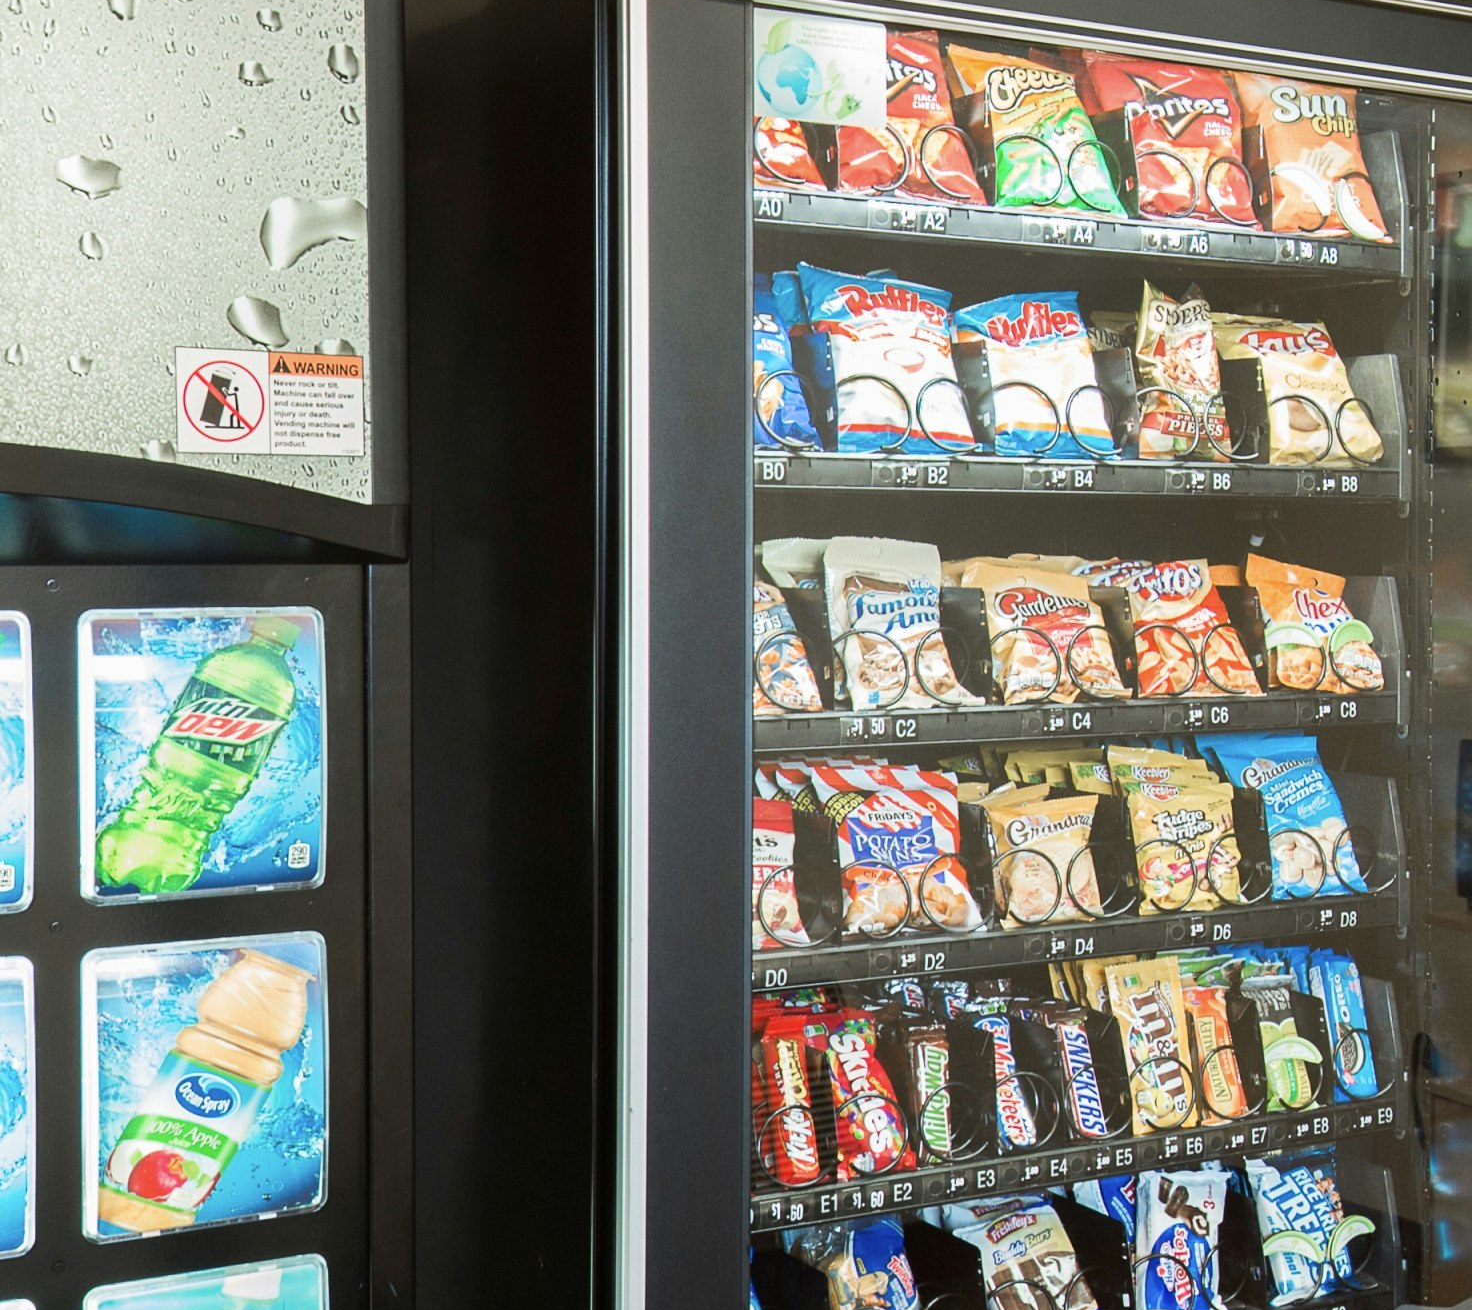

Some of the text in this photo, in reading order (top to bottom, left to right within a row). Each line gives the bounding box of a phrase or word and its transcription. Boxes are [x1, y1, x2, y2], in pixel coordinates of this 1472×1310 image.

[1270, 85, 1348, 123] Sun
[758, 199, 782, 217] A0
[923, 210, 946, 230] A2
[1073, 225, 1094, 243] A4
[1189, 236, 1208, 254] A6
[1319, 246, 1338, 265] A8
[835, 284, 948, 328] Ruffles
[985, 301, 1082, 348] Ruffles
[1246, 328, 1329, 357] Lay's
[293, 361, 359, 376] WARNING
[274, 379, 297, 388] Never
[298, 380, 316, 388] rock
[1285, 374, 1348, 394] Classic
[274, 389, 307, 398] Machine
[324, 391, 336, 399] fall
[274, 399, 288, 407] and
[316, 400, 344, 409] serious
[274, 409, 296, 419] injury
[274, 420, 355, 429] Vending machine will
[1167, 419, 1224, 438] PIECES
[274, 430, 288, 438] not
[289, 430, 324, 440] dispense
[762, 462, 785, 480] B0
[927, 466, 948, 485] B2
[1074, 470, 1094, 488] B4
[1212, 472, 1231, 491] B6
[1341, 474, 1358, 493] B8
[1294, 589, 1347, 620] Chex
[1211, 706, 1229, 724] C6
[1340, 701, 1357, 718] C8
[895, 719, 916, 738] C2
[1072, 712, 1092, 730] C4
[1264, 769, 1324, 805] Sandwich
[1270, 779, 1290, 793] Mini
[1273, 781, 1325, 813] Cremes
[1153, 809, 1205, 829] Fudge
[1160, 819, 1213, 842] Stripes
[292, 846, 308, 856] 290
[855, 833, 933, 853] POTATO
[1175, 840, 1205, 860] minis
[1340, 911, 1357, 927] D8
[1213, 923, 1232, 941] D6
[1074, 937, 1094, 956] D4
[923, 953, 945, 971] D2
[765, 968, 788, 986] D0
[1333, 974, 1350, 1023] OREO
[1198, 1018, 1230, 1100] NATURE VALLEY
[1063, 1025, 1106, 1135] SNICKERS
[178, 1081, 231, 1114] Ocean Spray
[829, 1033, 893, 1153] Skittles
[1313, 1117, 1329, 1133] E8
[1377, 1107, 1393, 1124] E9
[148, 1120, 222, 1150] 100% Apple
[1251, 1127, 1267, 1144] E7
[1186, 1137, 1203, 1154] E6
[1115, 1148, 1133, 1166] E5
[1050, 1158, 1067, 1177] E4
[977, 1170, 995, 1188] E3
[1293, 1169, 1322, 1204] RICE
[893, 1183, 913, 1202] E2
[821, 1194, 838, 1213] E1
[1203, 1200, 1216, 1210] 3
[990, 1214, 1035, 1241] Freshley's
[1263, 1175, 1336, 1284] TREAS
[993, 1228, 1051, 1266] Buddy Bars
[887, 1256, 914, 1298] Twinkies
